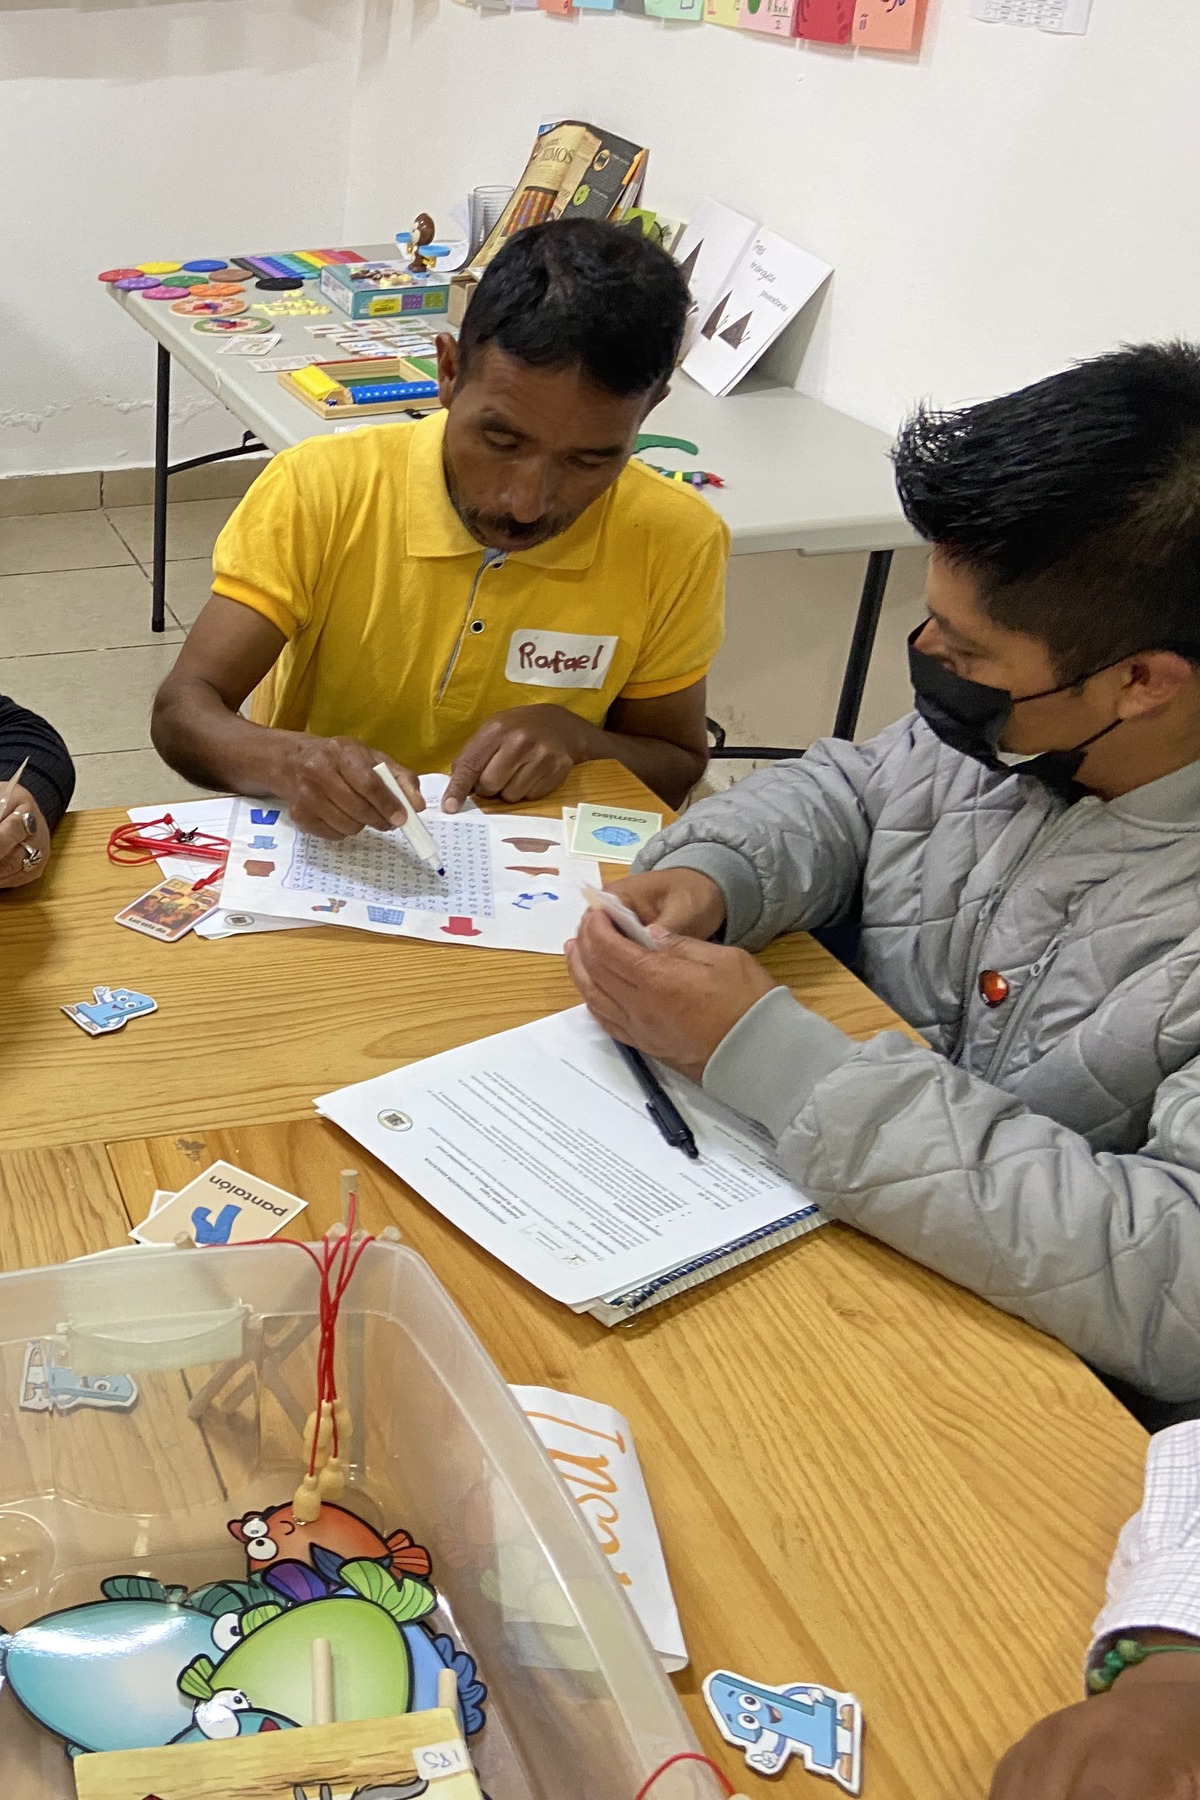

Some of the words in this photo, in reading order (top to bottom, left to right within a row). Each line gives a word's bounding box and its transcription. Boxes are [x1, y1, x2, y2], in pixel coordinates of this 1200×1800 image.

[518, 641, 604, 674] Rafael
[591, 812, 647, 824] camisa
[209, 1175, 288, 1217] pantalón
